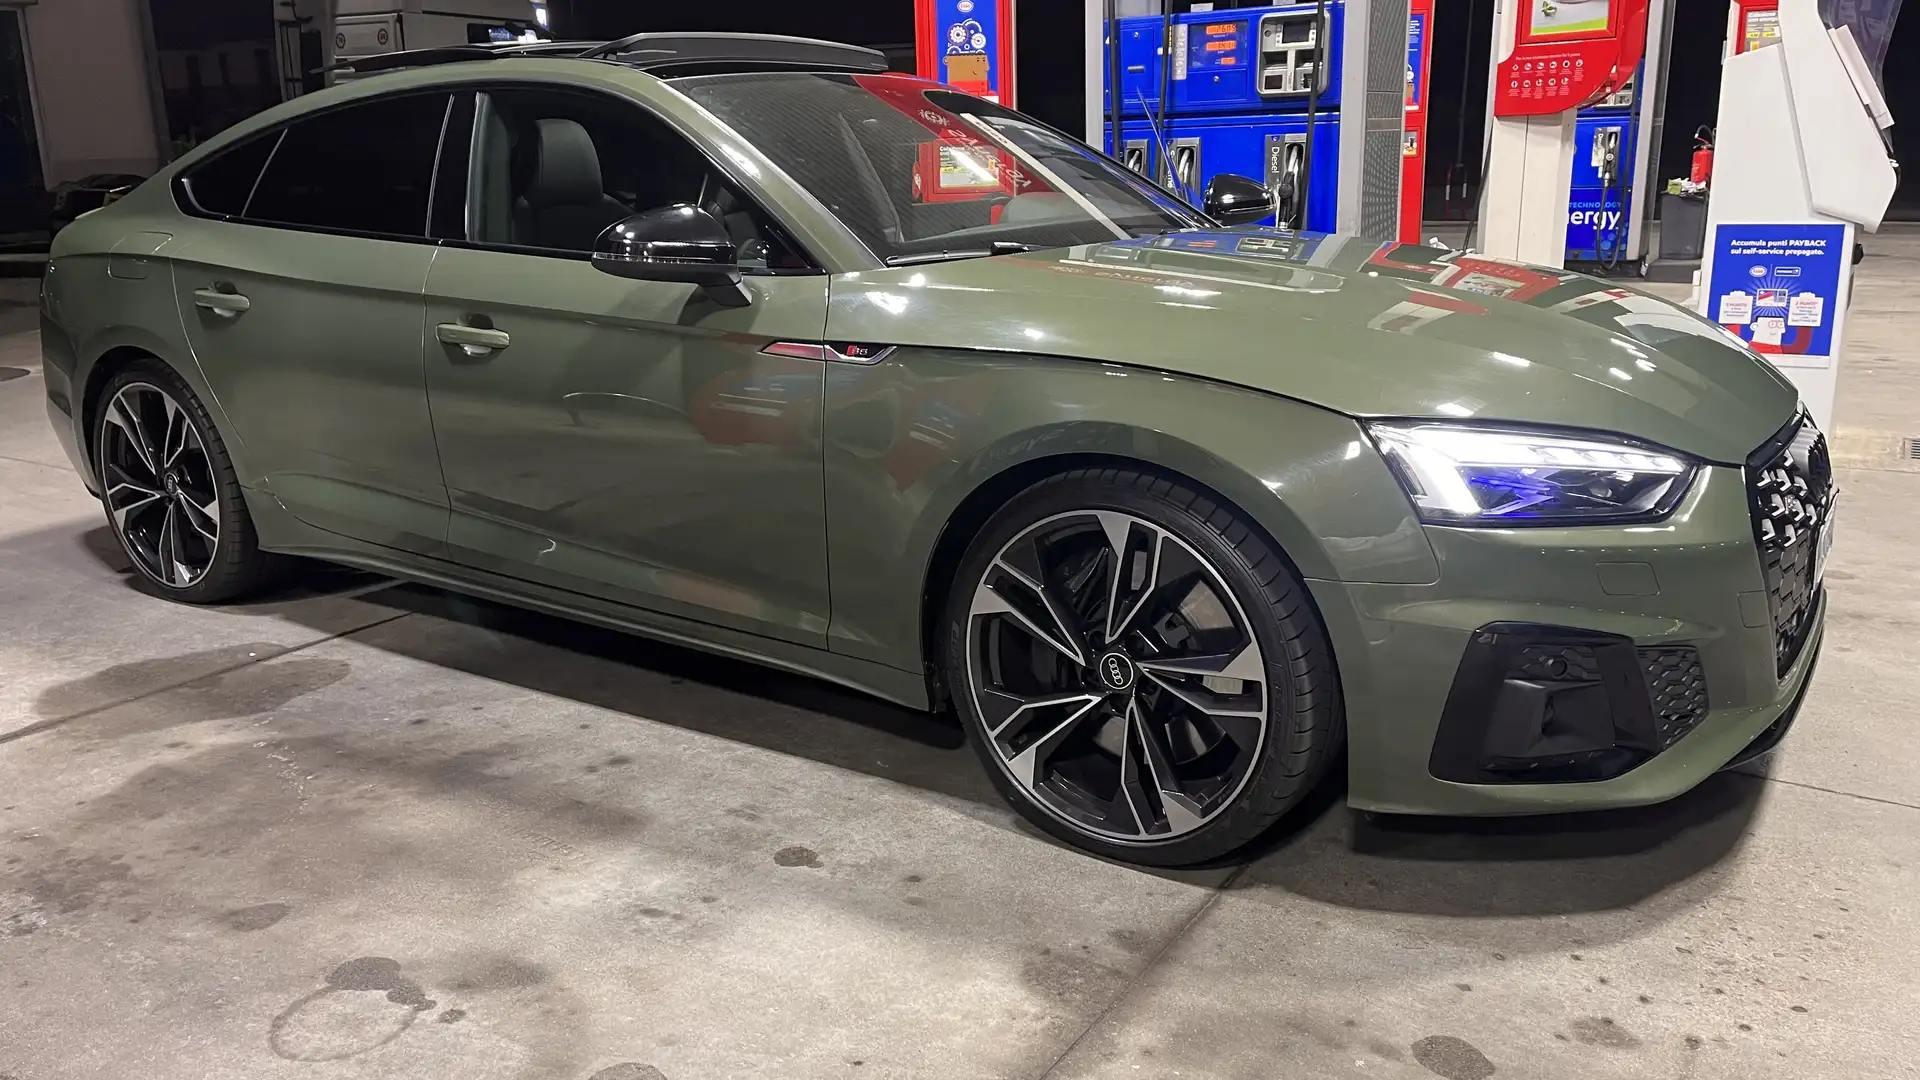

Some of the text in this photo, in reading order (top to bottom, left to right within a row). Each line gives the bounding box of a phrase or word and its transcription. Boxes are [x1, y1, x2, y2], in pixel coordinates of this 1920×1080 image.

[1271, 146, 1280, 174] Diesel
[1569, 201, 1622, 209] TECHNOOGY
[1567, 211, 1621, 230] ergy
[1767, 239, 1788, 247] punti
[1789, 239, 1827, 247] PAYBACK
[1730, 247, 1825, 256] sul self-service prepagato.
